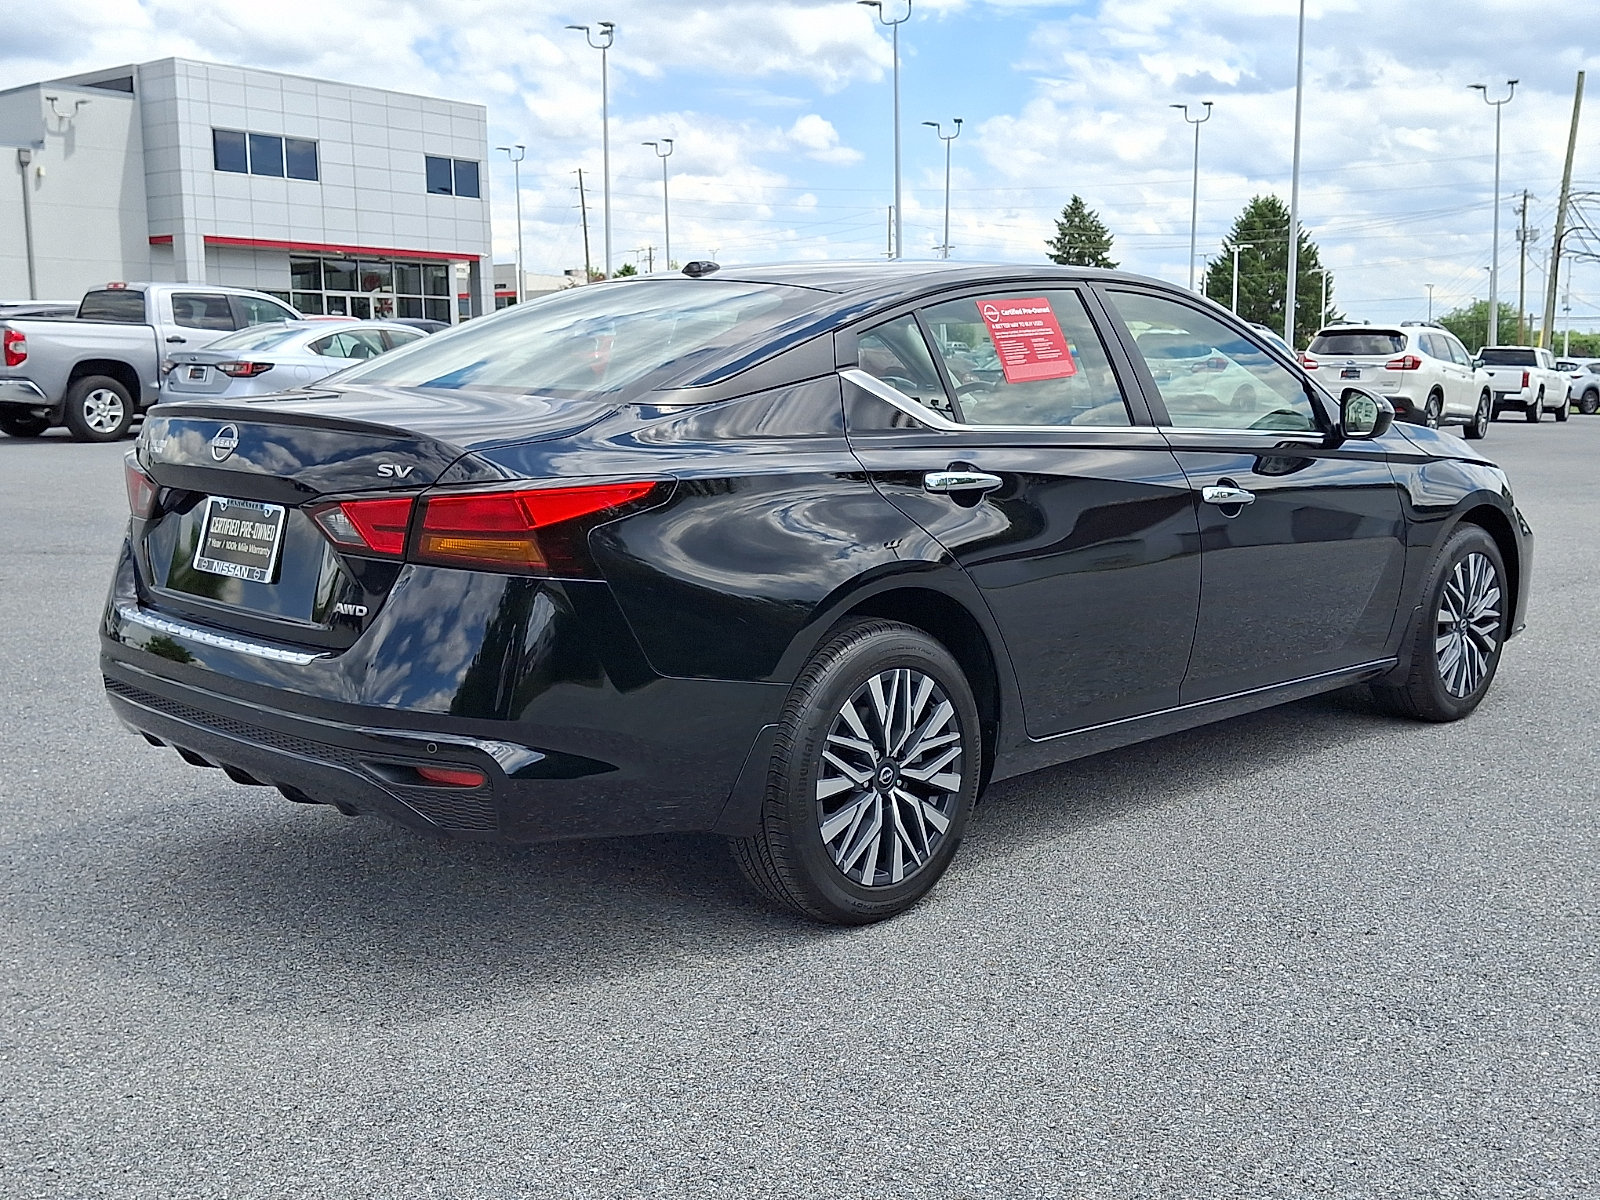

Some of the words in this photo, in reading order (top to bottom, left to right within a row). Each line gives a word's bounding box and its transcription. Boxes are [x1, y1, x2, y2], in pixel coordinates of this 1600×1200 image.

[377, 464, 414, 478] SV
[210, 516, 240, 536] CERTIFIED
[239, 520, 275, 541] PRE-OWNED
[211, 538, 221, 548] Year
[238, 542, 248, 552] Mile
[249, 543, 271, 558] Warranty
[212, 561, 249, 578] NISSAN
[333, 602, 368, 617] AWD
